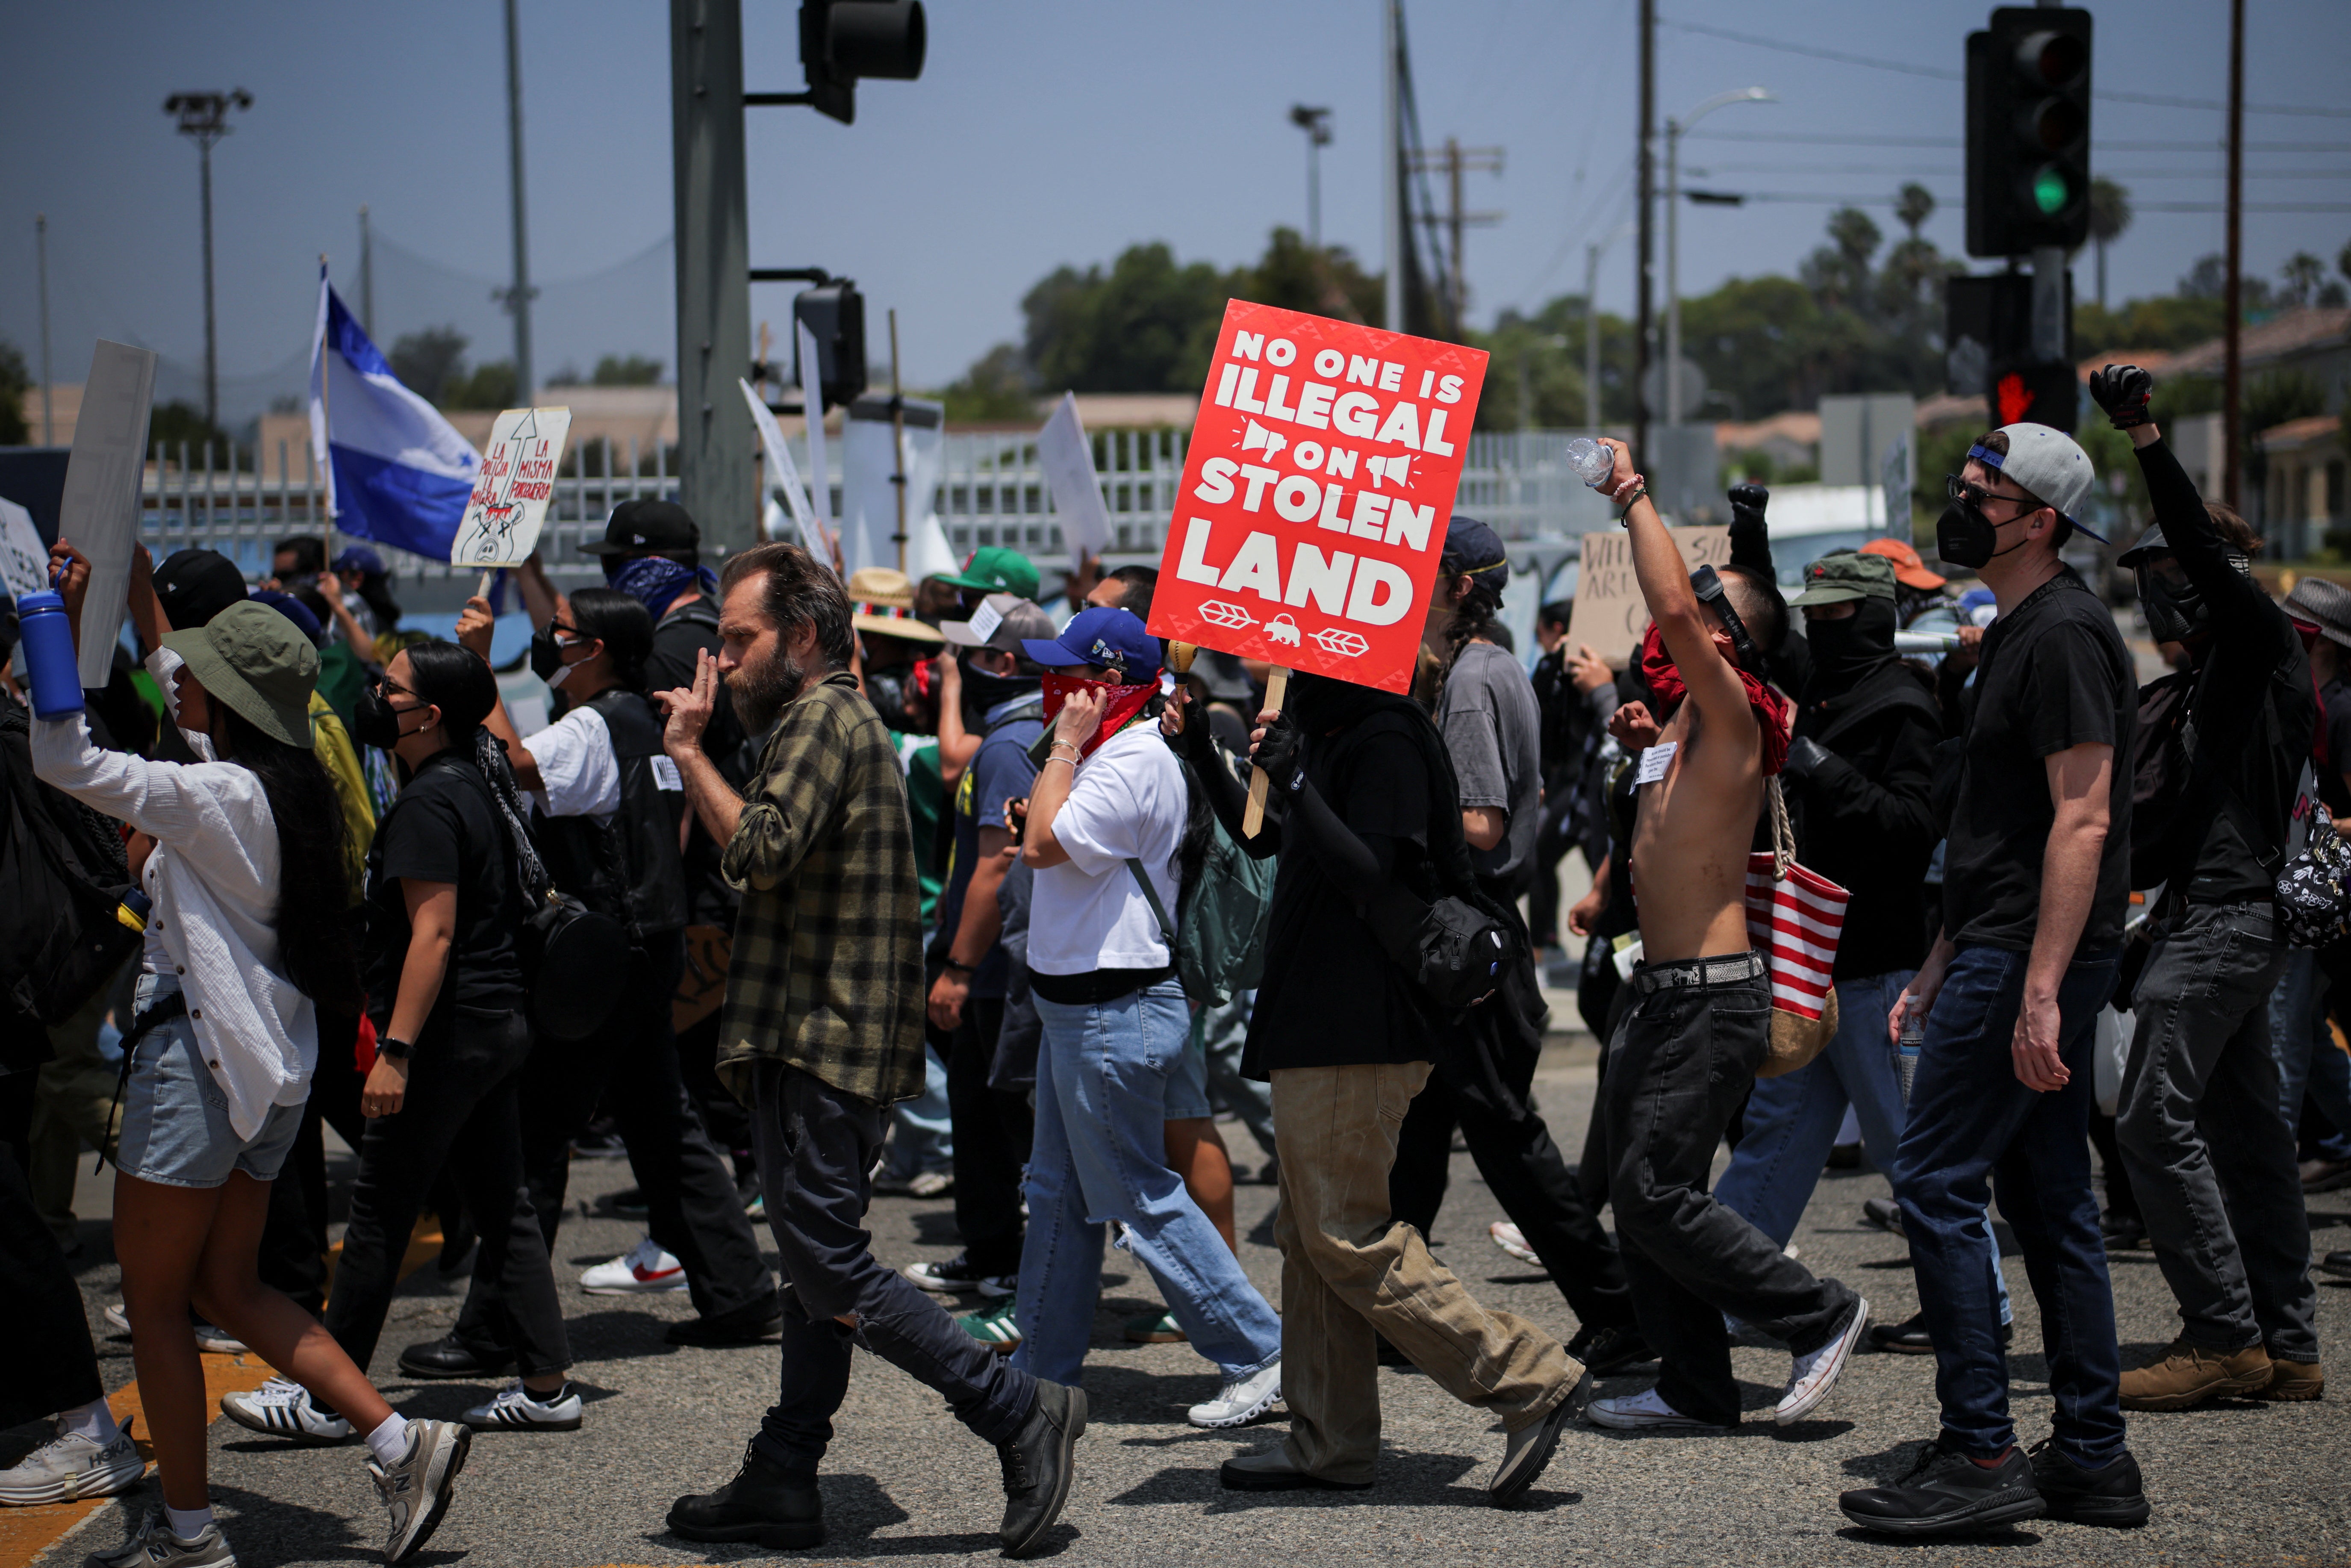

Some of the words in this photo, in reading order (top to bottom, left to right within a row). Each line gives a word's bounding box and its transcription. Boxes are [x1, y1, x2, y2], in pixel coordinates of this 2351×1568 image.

[1231, 330, 1296, 367] NO
[1314, 349, 1405, 392] ONE
[1419, 370, 1464, 404] IS
[1214, 363, 1454, 457] ILLEGAL
[492, 442, 506, 461] LA
[535, 439, 548, 457] LA
[518, 460, 553, 479] MISMA
[1293, 441, 1359, 480] ON
[483, 476, 494, 492] LA
[469, 491, 497, 508] MIGRA
[1193, 457, 1435, 552] STOLEN
[1176, 517, 1413, 625] LAND
[88, 1439, 131, 1468] HOKA
[1920, 1479, 1938, 1488] BROOKS
